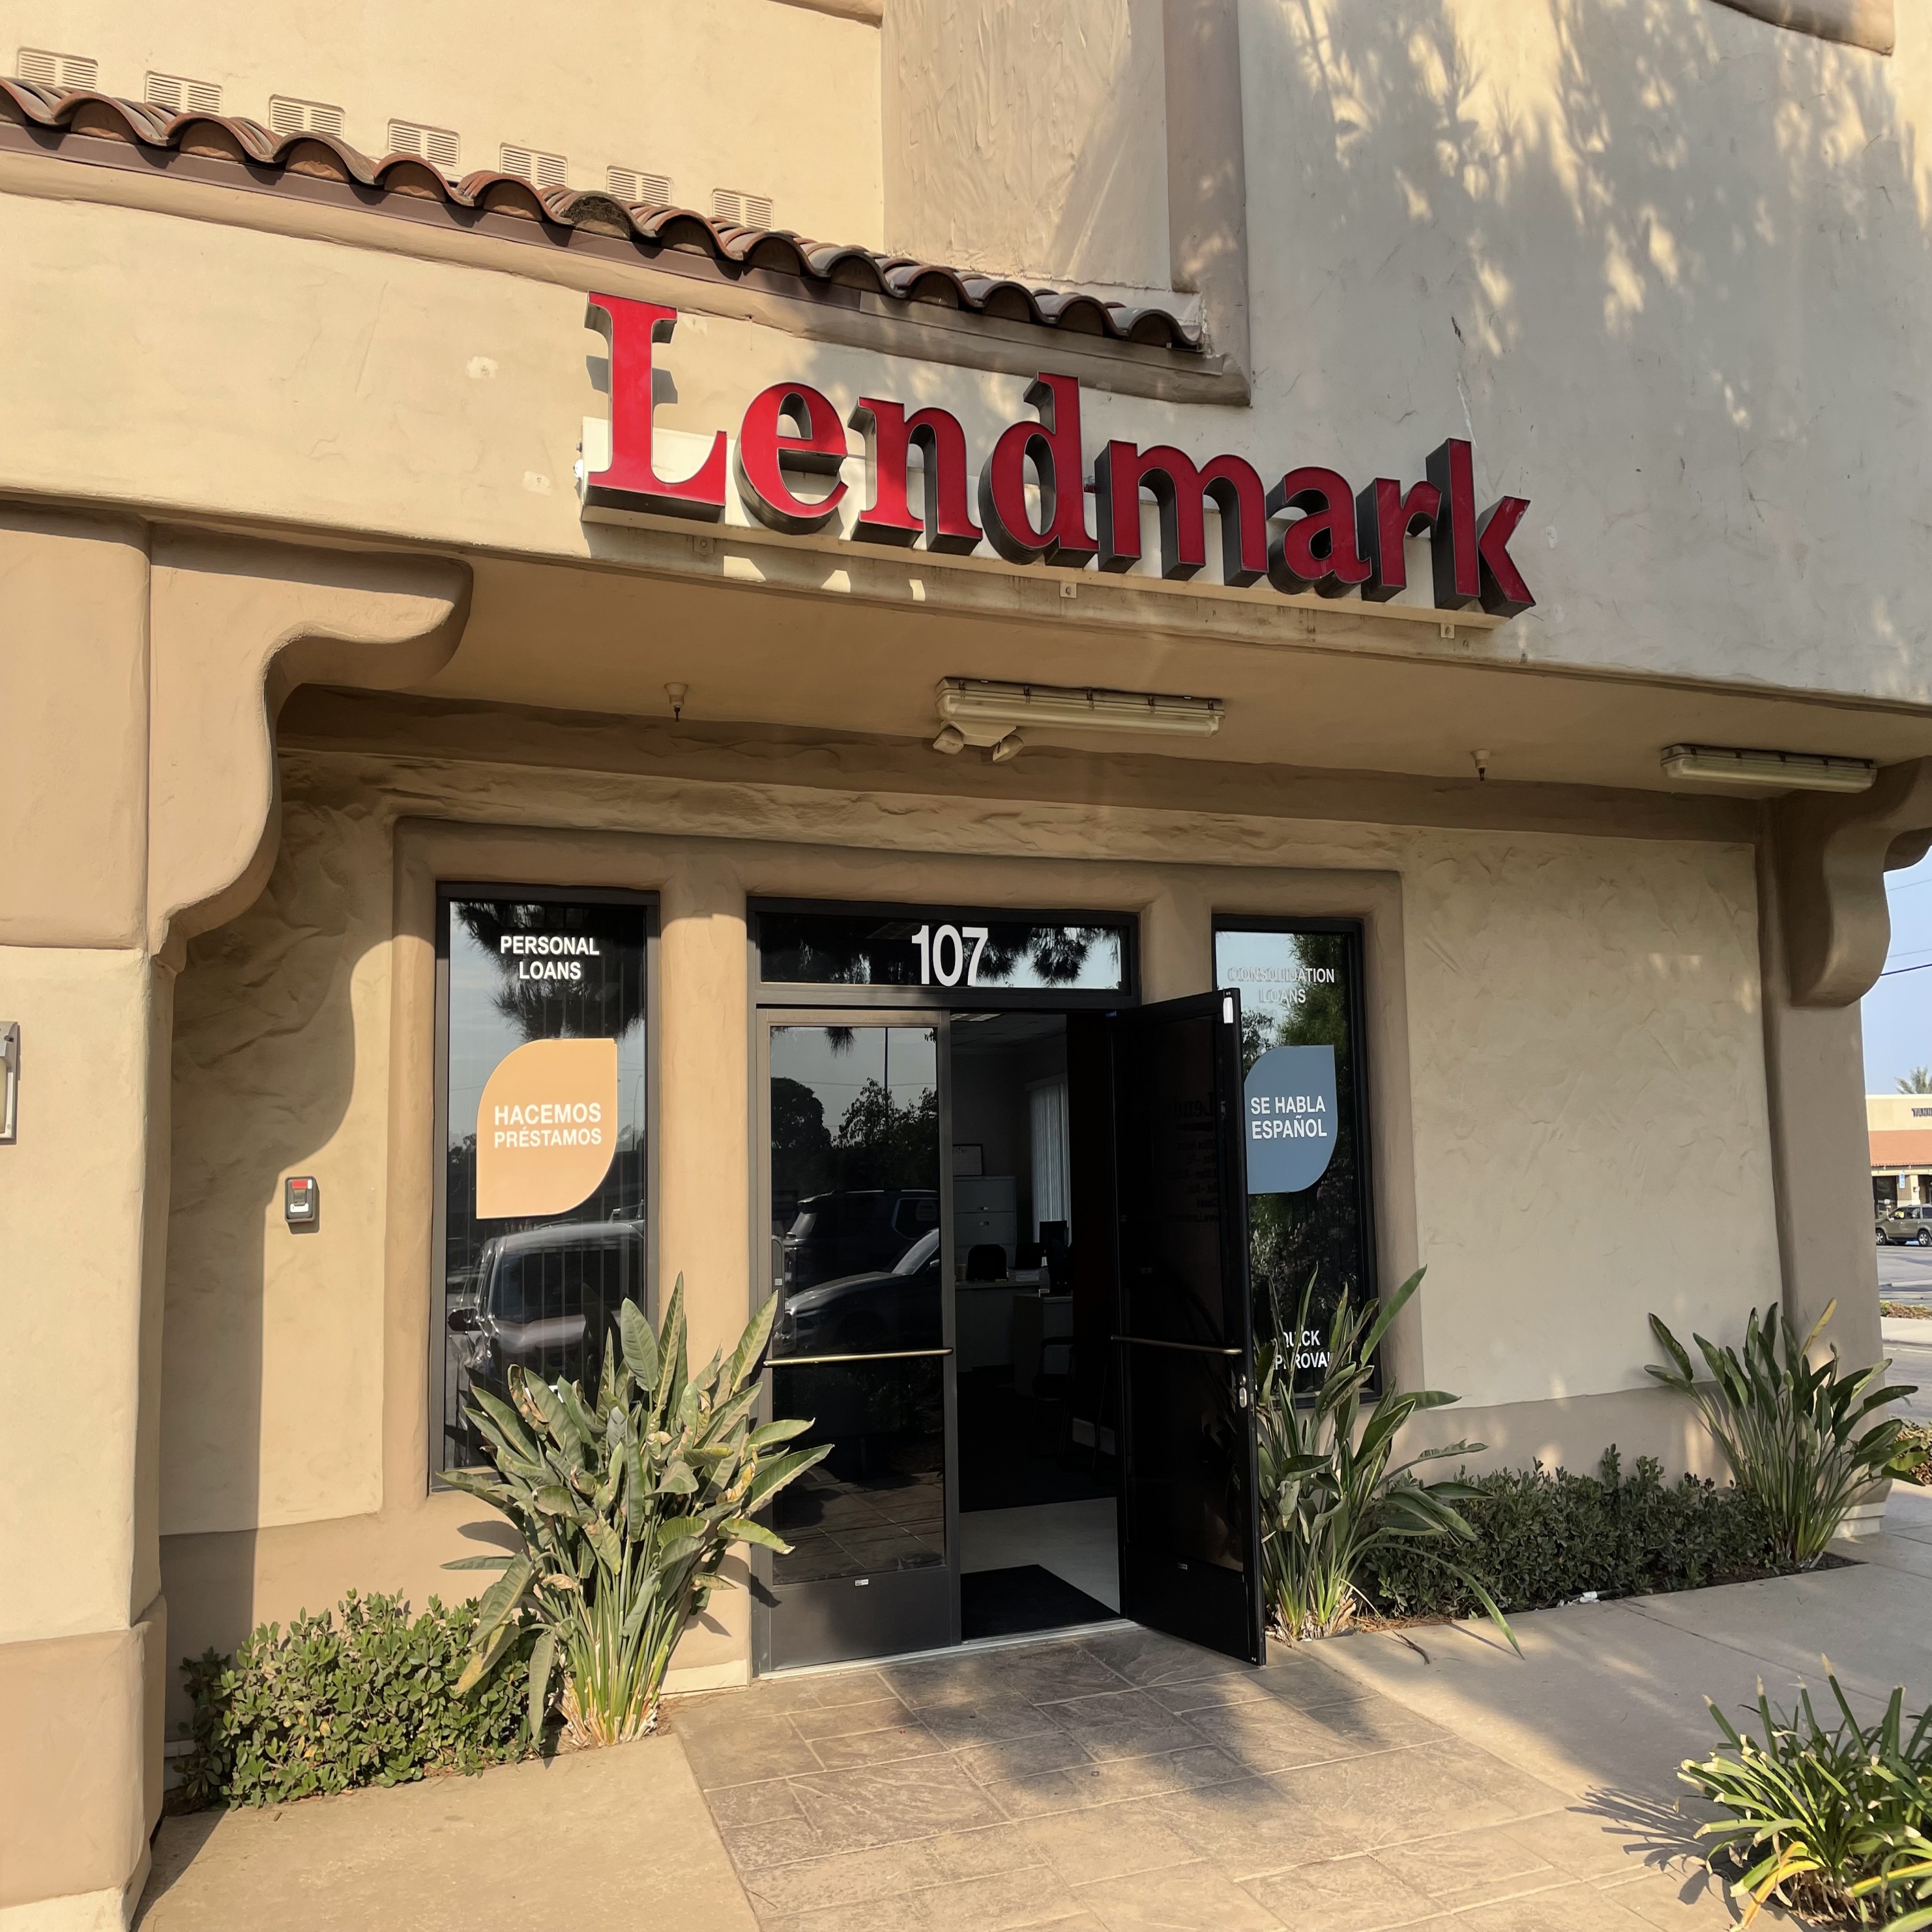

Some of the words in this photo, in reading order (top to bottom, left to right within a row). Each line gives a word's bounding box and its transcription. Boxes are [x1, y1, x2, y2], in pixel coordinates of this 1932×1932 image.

[584, 290, 1535, 616] Lendmark
[500, 935, 600, 956] PERSONAL
[911, 924, 989, 987] 107
[519, 961, 582, 980] LOANS
[1229, 967, 1335, 983] CONSOLIDATION
[1262, 988, 1307, 1003] LOANS
[494, 1102, 602, 1126] HACEMOS
[1251, 1097, 1271, 1115] SE
[1274, 1095, 1326, 1113] HABLA
[494, 1126, 602, 1148] PRÉSTAMOS
[1251, 1115, 1327, 1139] ESPAÑOL
[1282, 1330, 1321, 1348] QUCK
